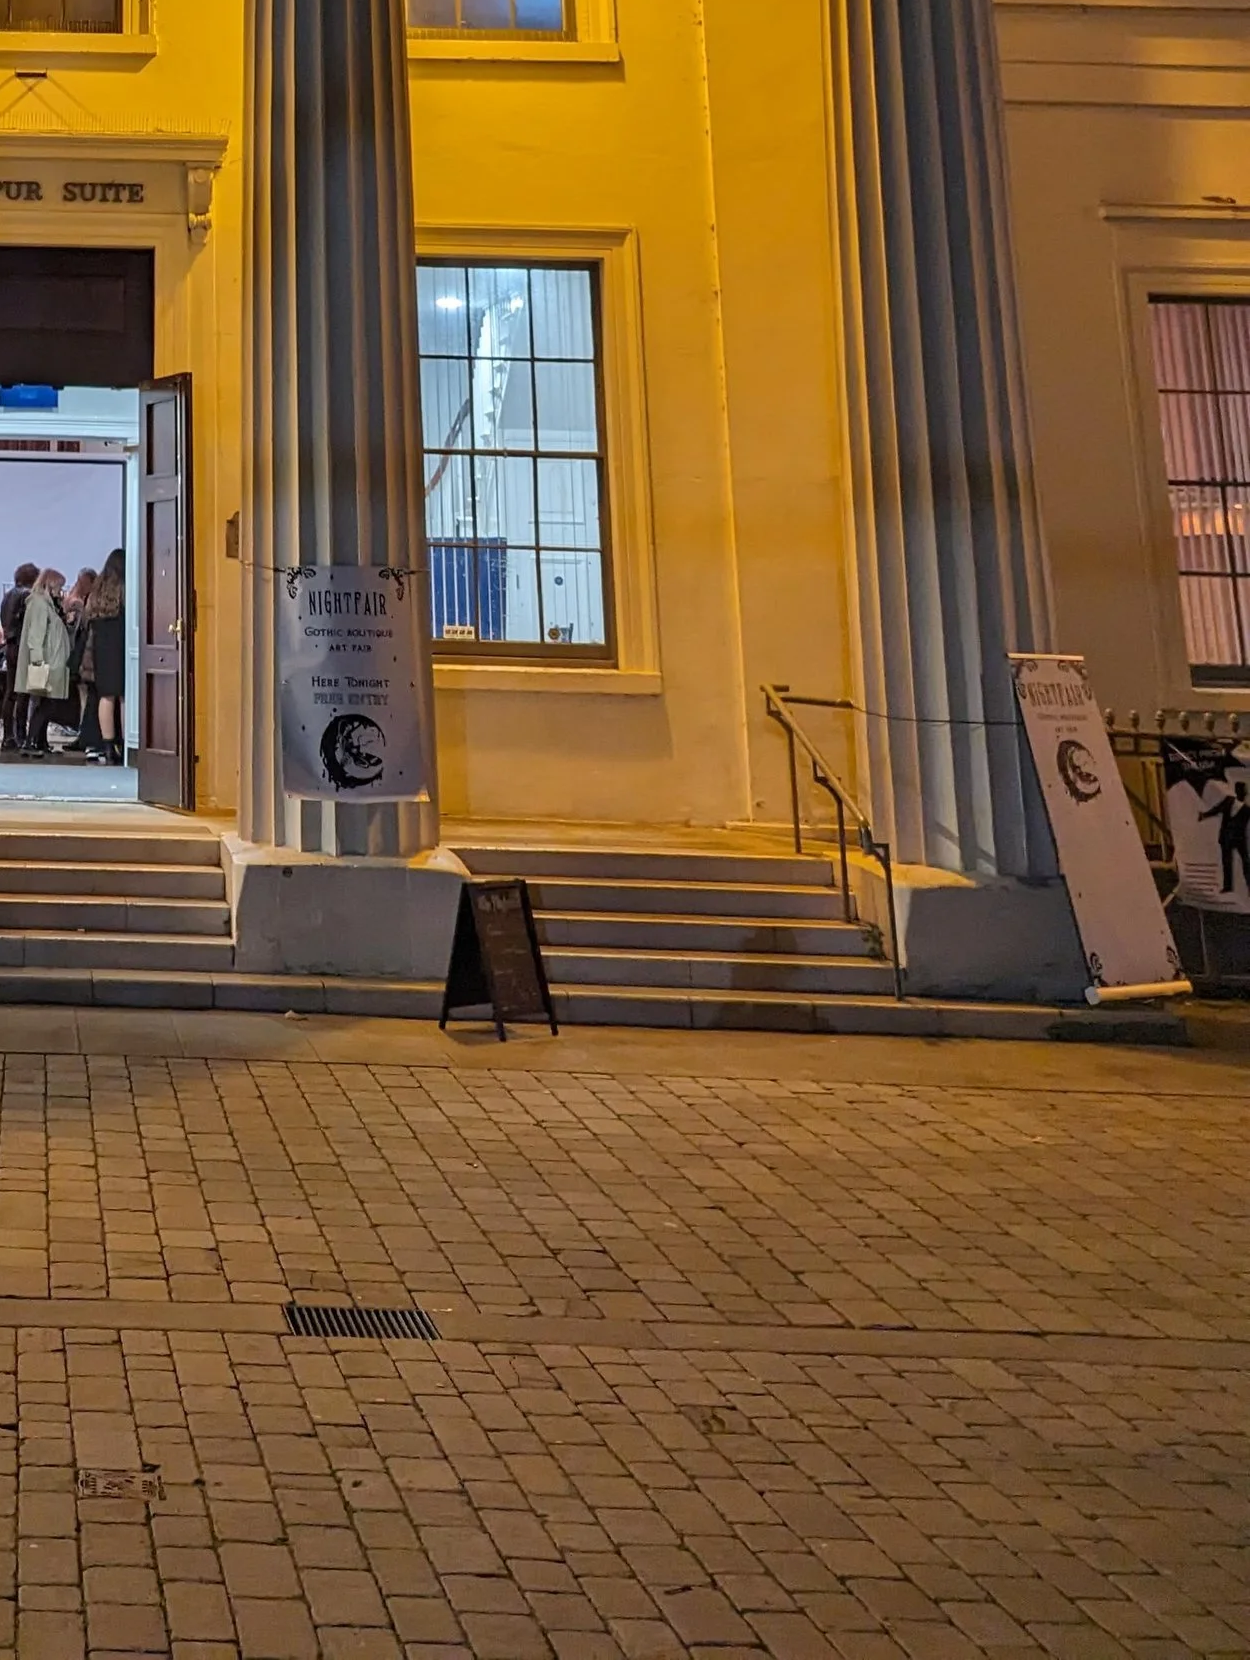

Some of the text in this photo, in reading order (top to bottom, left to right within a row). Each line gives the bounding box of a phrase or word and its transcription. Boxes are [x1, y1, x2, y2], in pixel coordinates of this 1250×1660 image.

[62, 182, 144, 203] SUITE
[309, 590, 387, 617] NIGHTFAIR
[304, 626, 393, 638] GOTHIC BOUTIQUE
[311, 676, 390, 688] HERE TONIGHT
